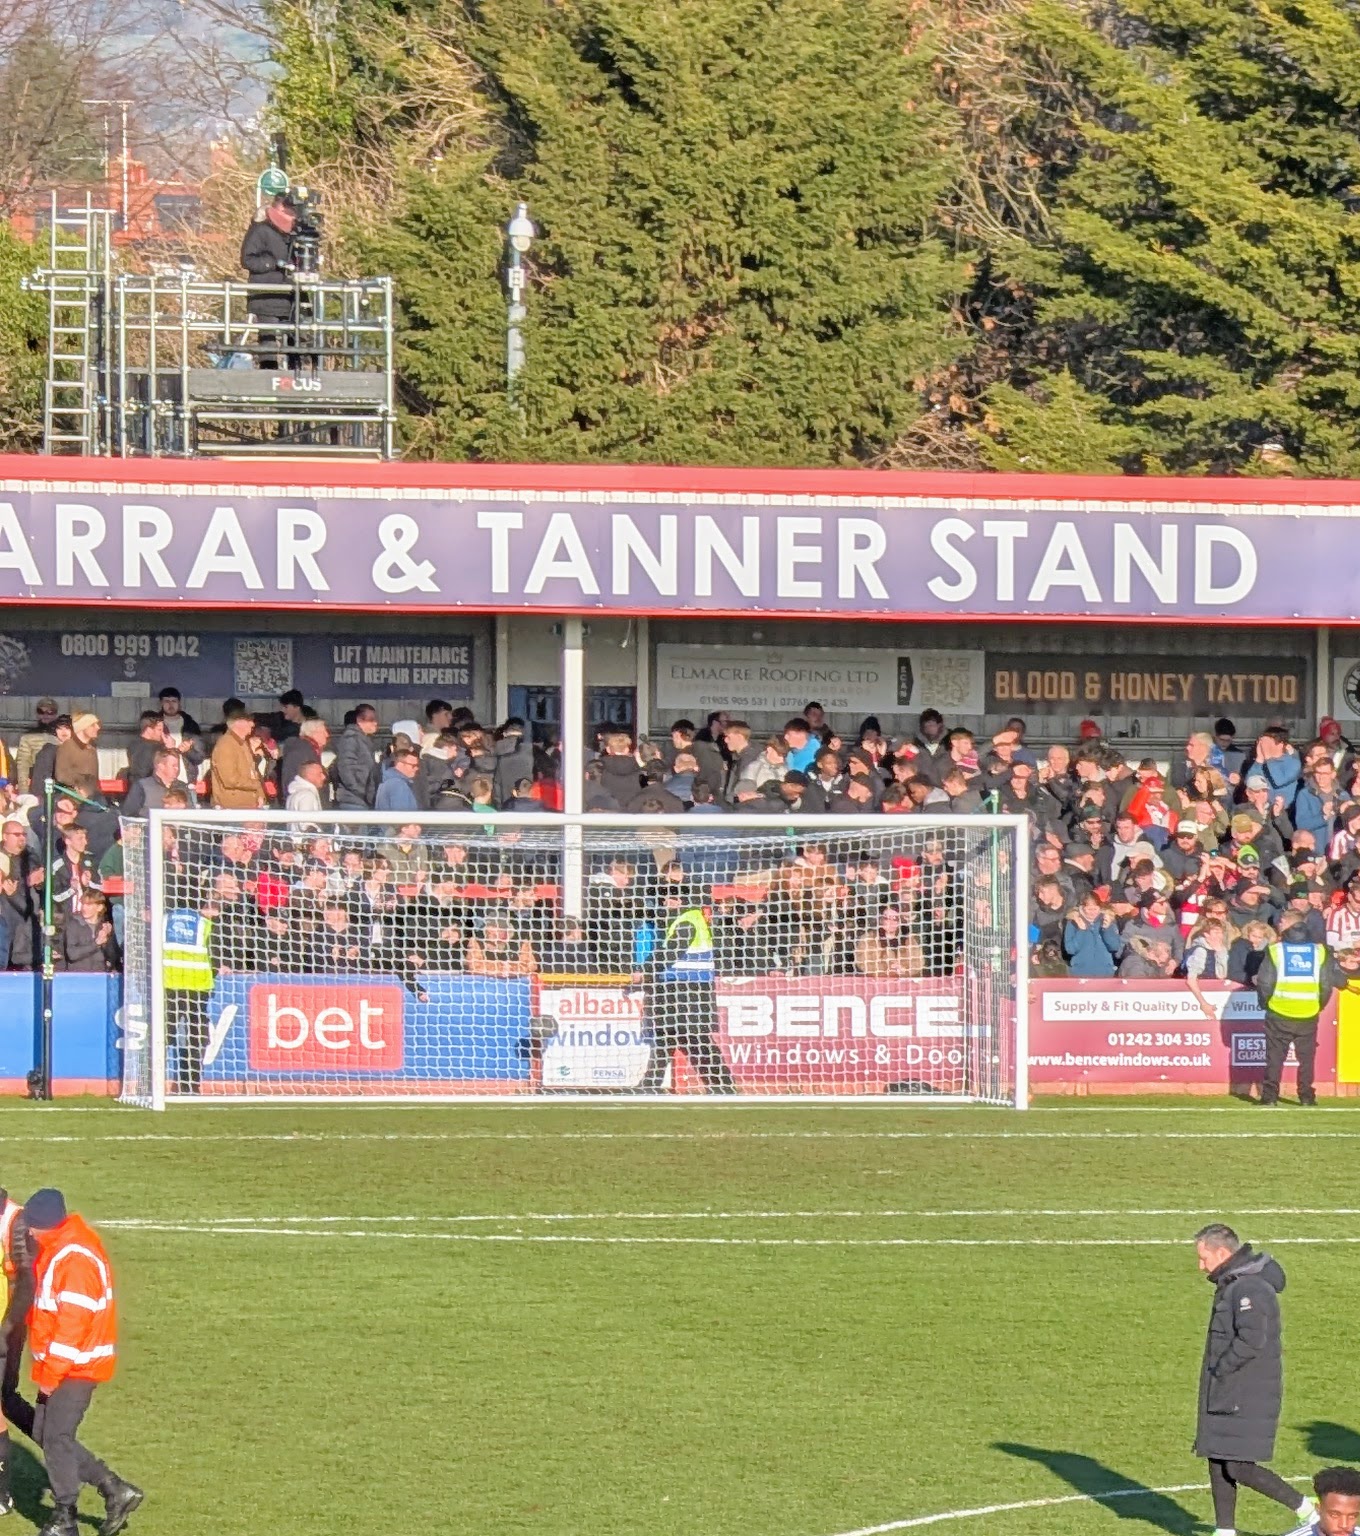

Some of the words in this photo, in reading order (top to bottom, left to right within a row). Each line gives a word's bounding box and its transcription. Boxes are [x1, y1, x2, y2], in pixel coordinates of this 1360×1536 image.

[271, 377, 322, 393] FOCUS
[371, 513, 441, 594] &
[476, 511, 890, 600] TANNER
[926, 519, 1259, 606] STAND
[61, 633, 109, 656] 0800
[113, 635, 151, 657] 999
[155, 636, 200, 659] 1042
[333, 645, 362, 663] LIFT
[365, 646, 469, 665] MAINTENANCE
[333, 667, 360, 684] AND
[364, 667, 410, 684] REPAIR
[412, 667, 469, 685] EXPERTS
[670, 665, 751, 682] ELMACRE
[759, 666, 841, 684] ROOFING
[845, 669, 880, 685] LTD
[994, 670, 1075, 699] BLOOD
[1085, 671, 1101, 699] &
[1110, 672, 1195, 701] HONEY
[1203, 673, 1298, 704] TATTOO
[1053, 1000, 1099, 1015] Supply
[1132, 1001, 1180, 1015] Quality
[266, 993, 387, 1050] bet
[1106, 1033, 1154, 1047] 01242
[1155, 1033, 1182, 1047] 304
[1184, 1033, 1211, 1047] 305
[729, 1044, 861, 1067] Windows
[1027, 1052, 1211, 1069] www.bencewindows.co.uk
